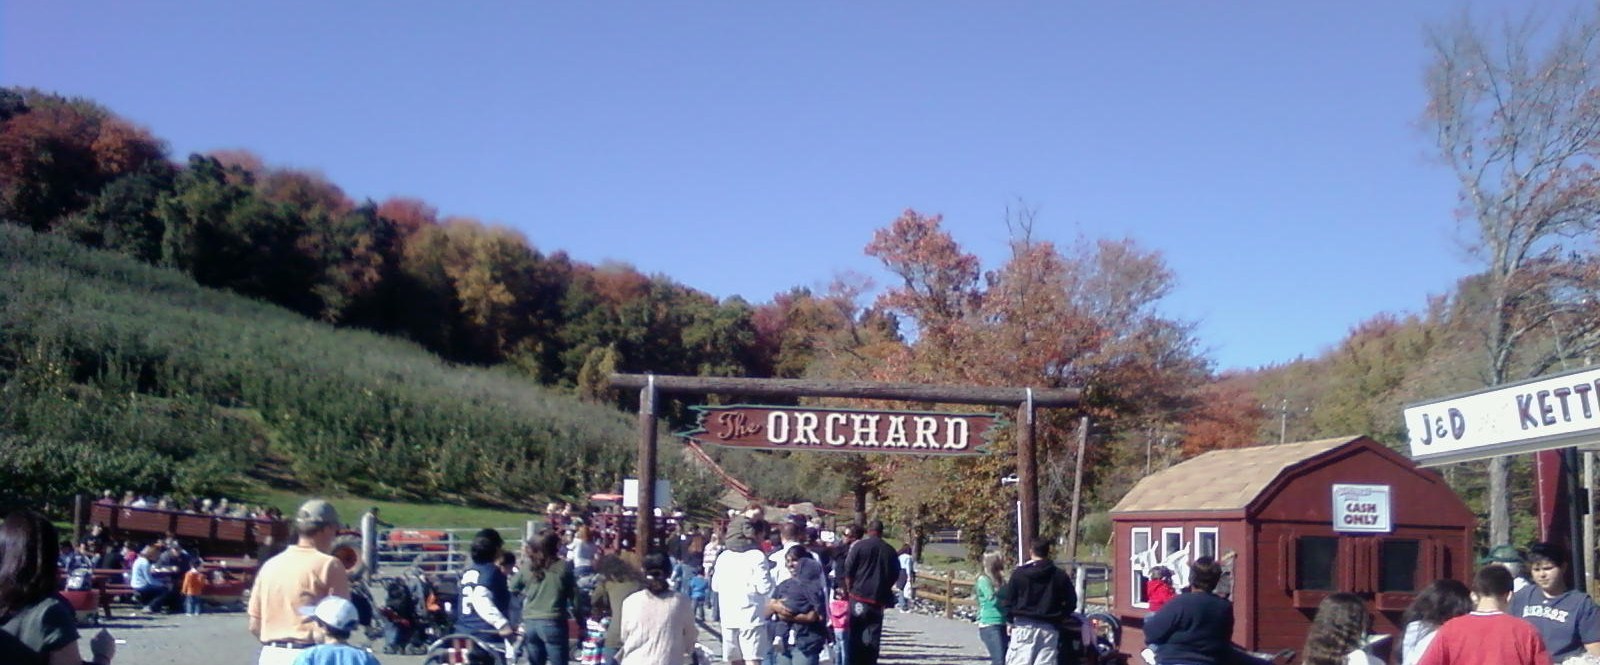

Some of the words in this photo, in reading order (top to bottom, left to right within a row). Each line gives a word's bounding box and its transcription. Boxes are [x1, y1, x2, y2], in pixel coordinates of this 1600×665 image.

[1420, 407, 1466, 446] J&D
[1515, 378, 1600, 431] KETT
[717, 409, 761, 440] The
[766, 410, 970, 450] ORCHARD
[1343, 514, 1379, 525] ONLY
[1345, 502, 1377, 513] CASH
